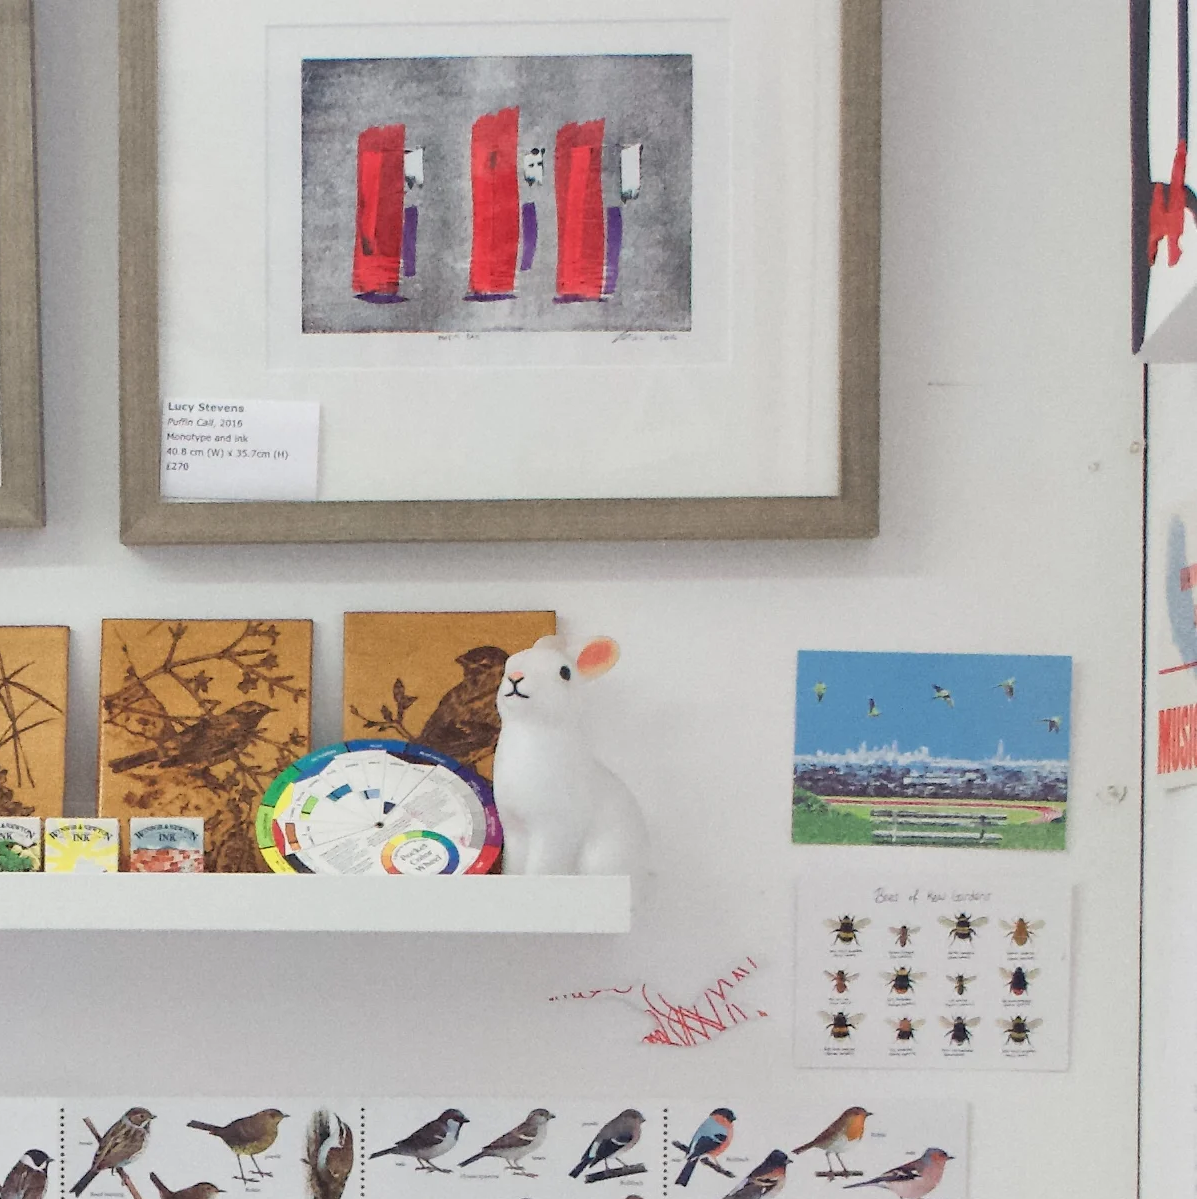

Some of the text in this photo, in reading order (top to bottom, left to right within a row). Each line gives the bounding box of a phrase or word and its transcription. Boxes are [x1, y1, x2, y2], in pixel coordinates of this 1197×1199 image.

[168, 402, 244, 413] Lucy Stevens
[167, 418, 193, 427] Puffin
[220, 419, 243, 428] 2016
[167, 433, 249, 443] Monotype and ink
[207, 448, 224, 458] (W)
[273, 449, 289, 460] (H)
[166, 462, 189, 471] £270
[73, 833, 89, 841] INK
[158, 833, 176, 841] INK
